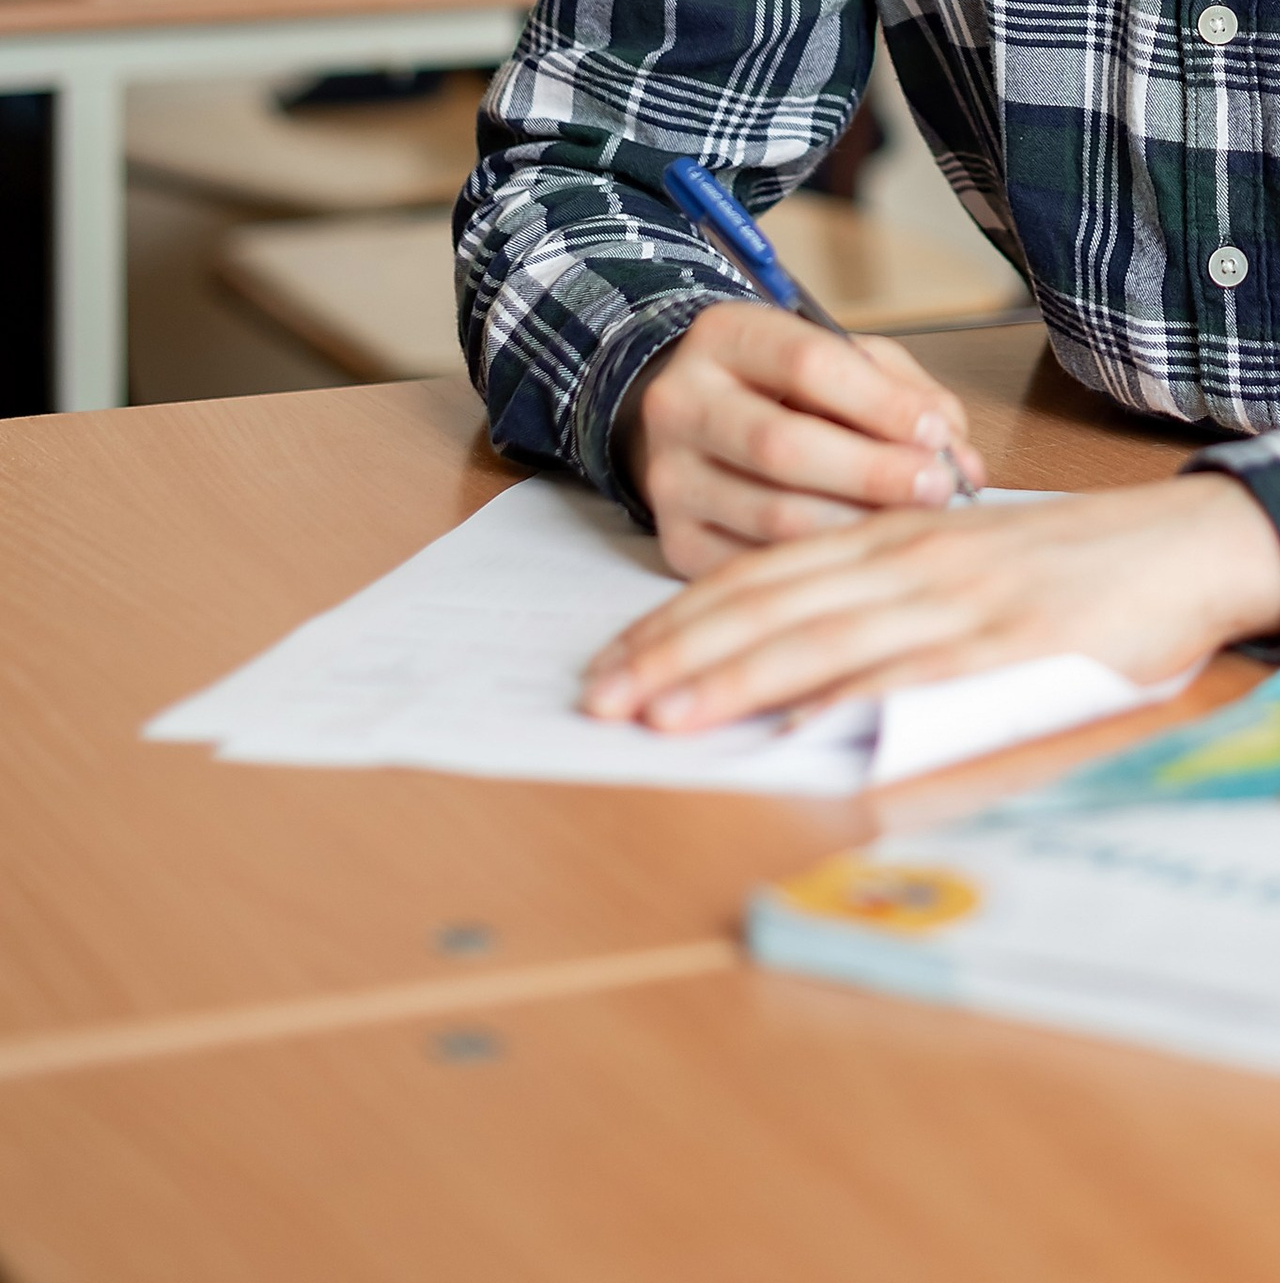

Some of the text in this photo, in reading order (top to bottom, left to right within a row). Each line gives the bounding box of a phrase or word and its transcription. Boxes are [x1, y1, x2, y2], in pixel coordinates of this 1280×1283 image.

[699, 181, 723, 203] GRIP
[717, 198, 746, 226] SUPER
[739, 225, 767, 252] PILOT
